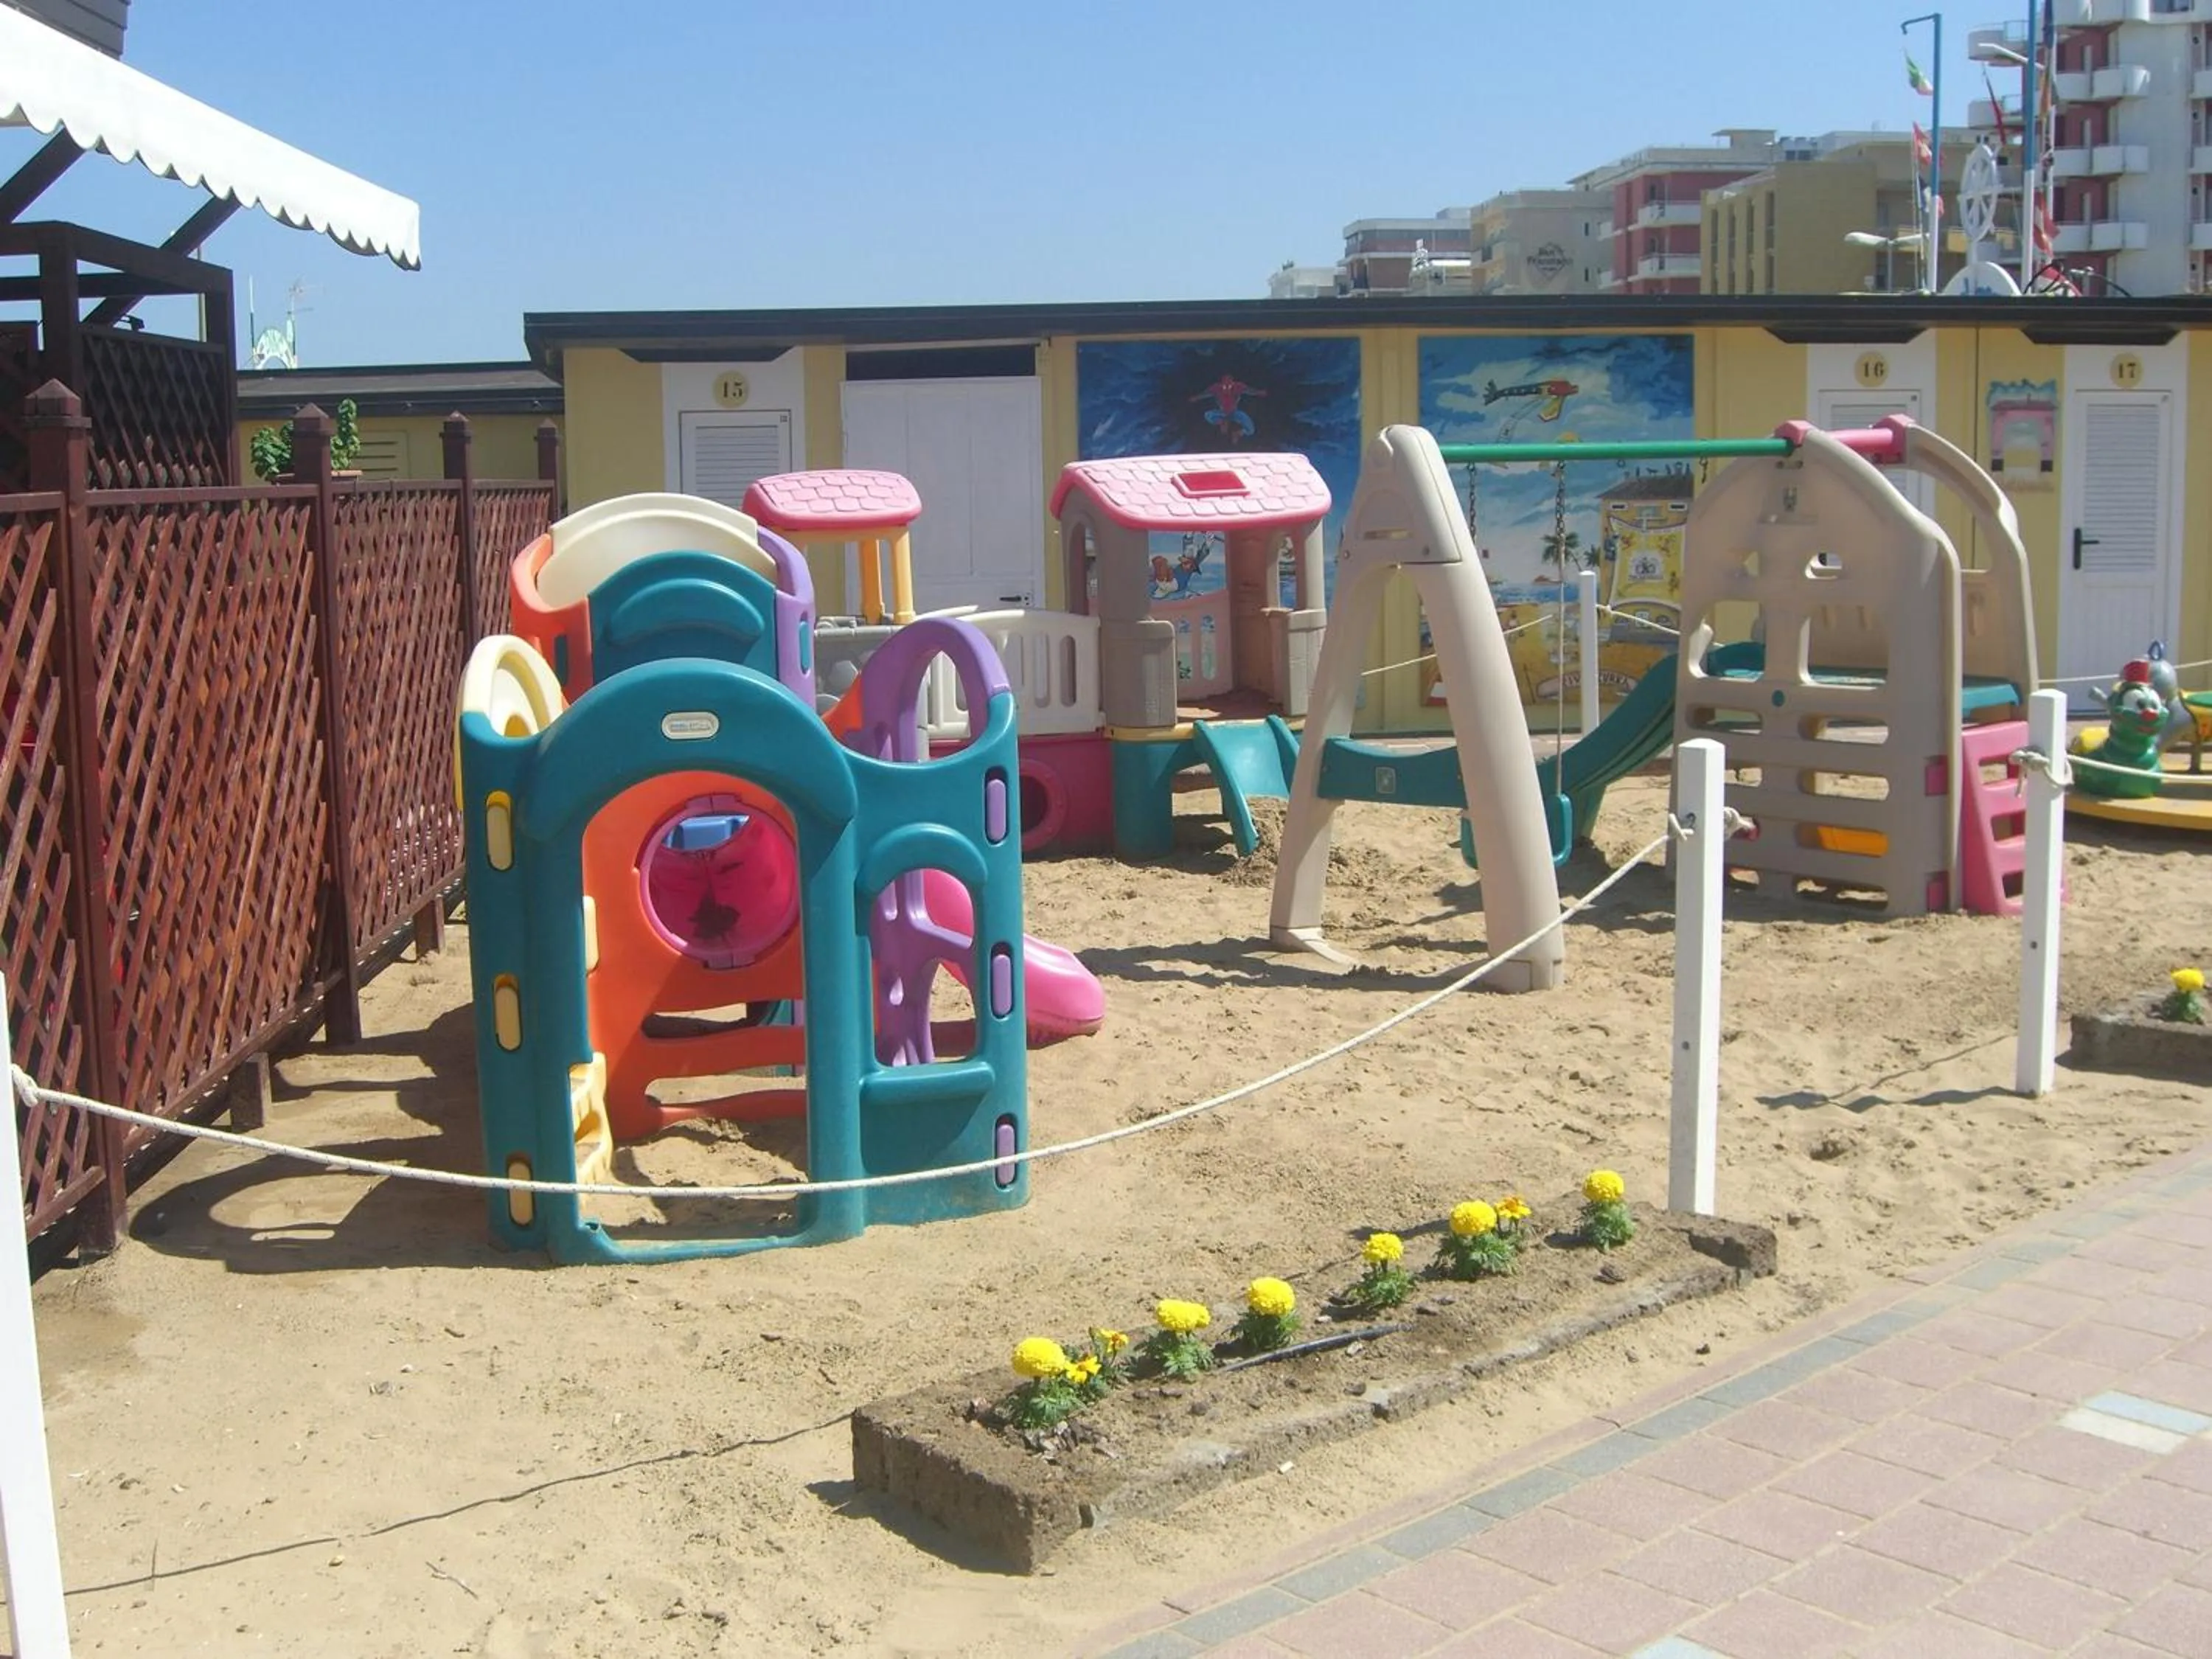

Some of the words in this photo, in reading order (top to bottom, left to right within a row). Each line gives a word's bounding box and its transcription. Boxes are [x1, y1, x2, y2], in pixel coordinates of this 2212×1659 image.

[1863, 361, 1884, 378] 16
[2118, 362, 2137, 378] 17
[722, 381, 743, 398] 15
